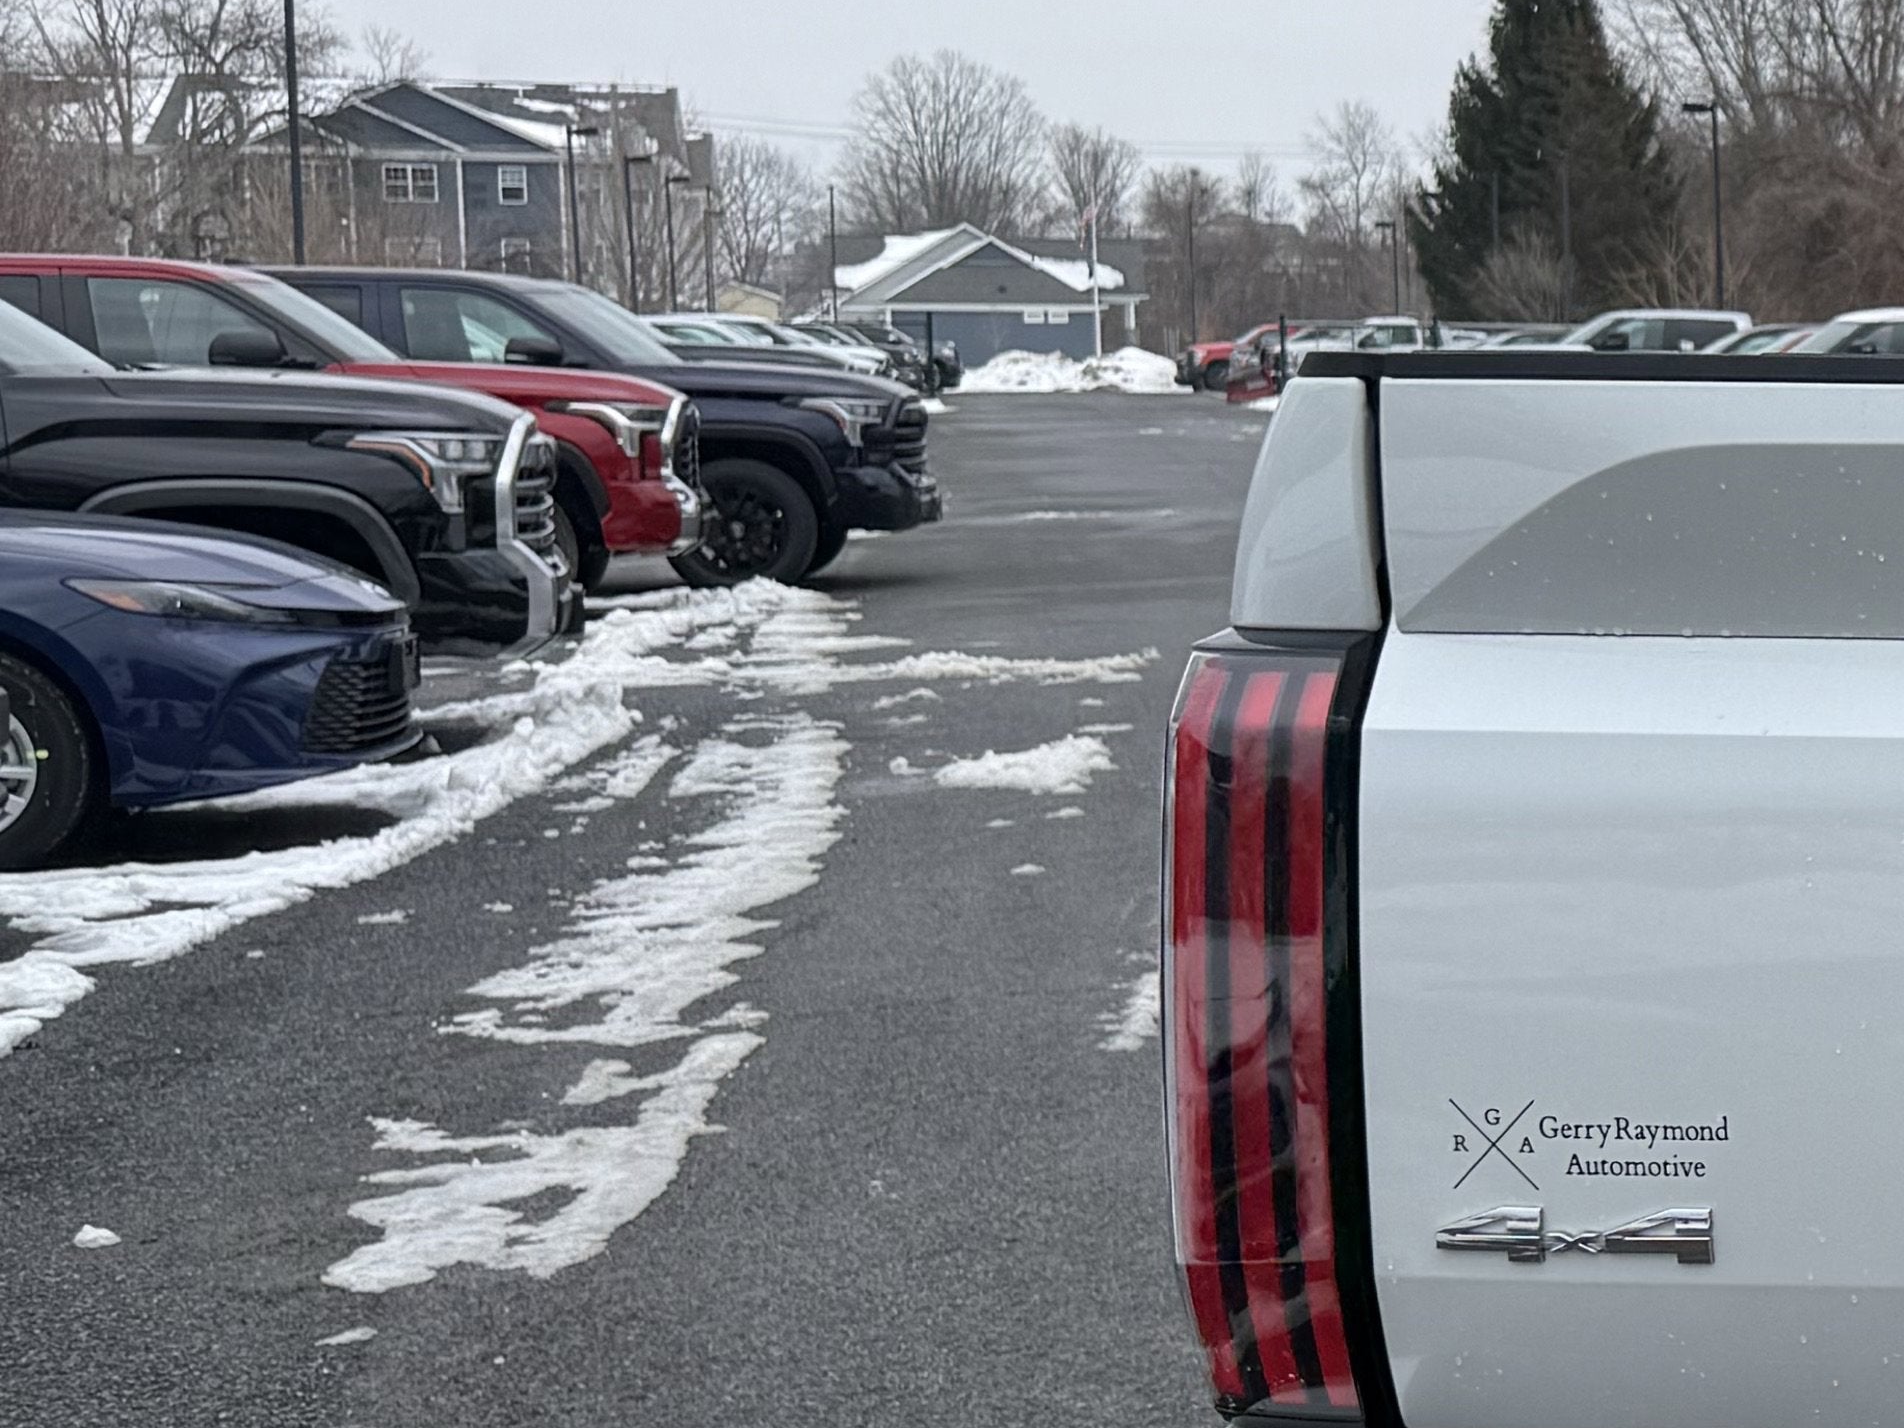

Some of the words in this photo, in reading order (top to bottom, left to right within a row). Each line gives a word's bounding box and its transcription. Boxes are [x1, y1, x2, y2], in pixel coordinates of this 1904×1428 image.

[1484, 1108, 1502, 1126] G
[1538, 1115, 1611, 1149] Gerry
[1613, 1115, 1730, 1149] Raymond
[1453, 1134, 1469, 1153] R
[1518, 1136, 1536, 1154] A
[1565, 1152, 1707, 1178] Automotive
